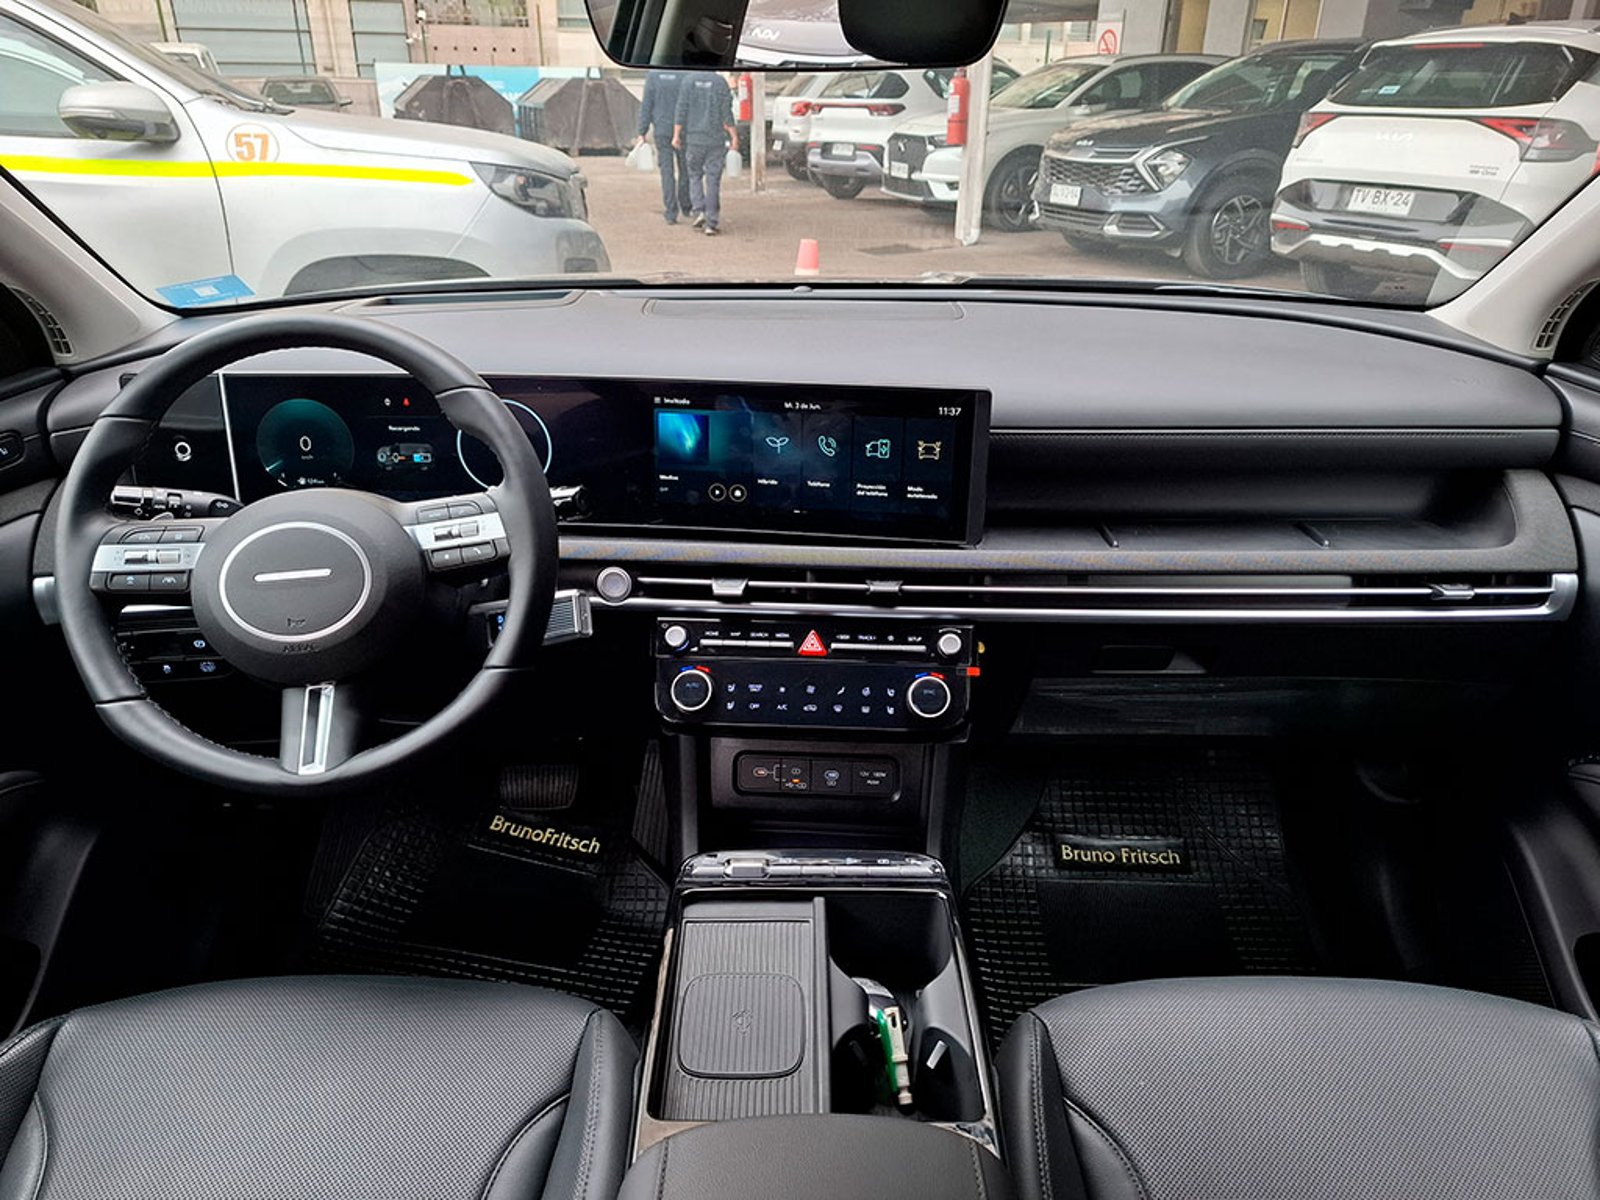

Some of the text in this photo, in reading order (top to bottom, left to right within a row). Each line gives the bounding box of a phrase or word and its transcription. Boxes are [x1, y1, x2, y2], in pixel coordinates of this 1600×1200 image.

[234, 133, 269, 161] 57
[938, 407, 962, 416] 11:37
[1061, 844, 1181, 864] Bruno Fritsch
